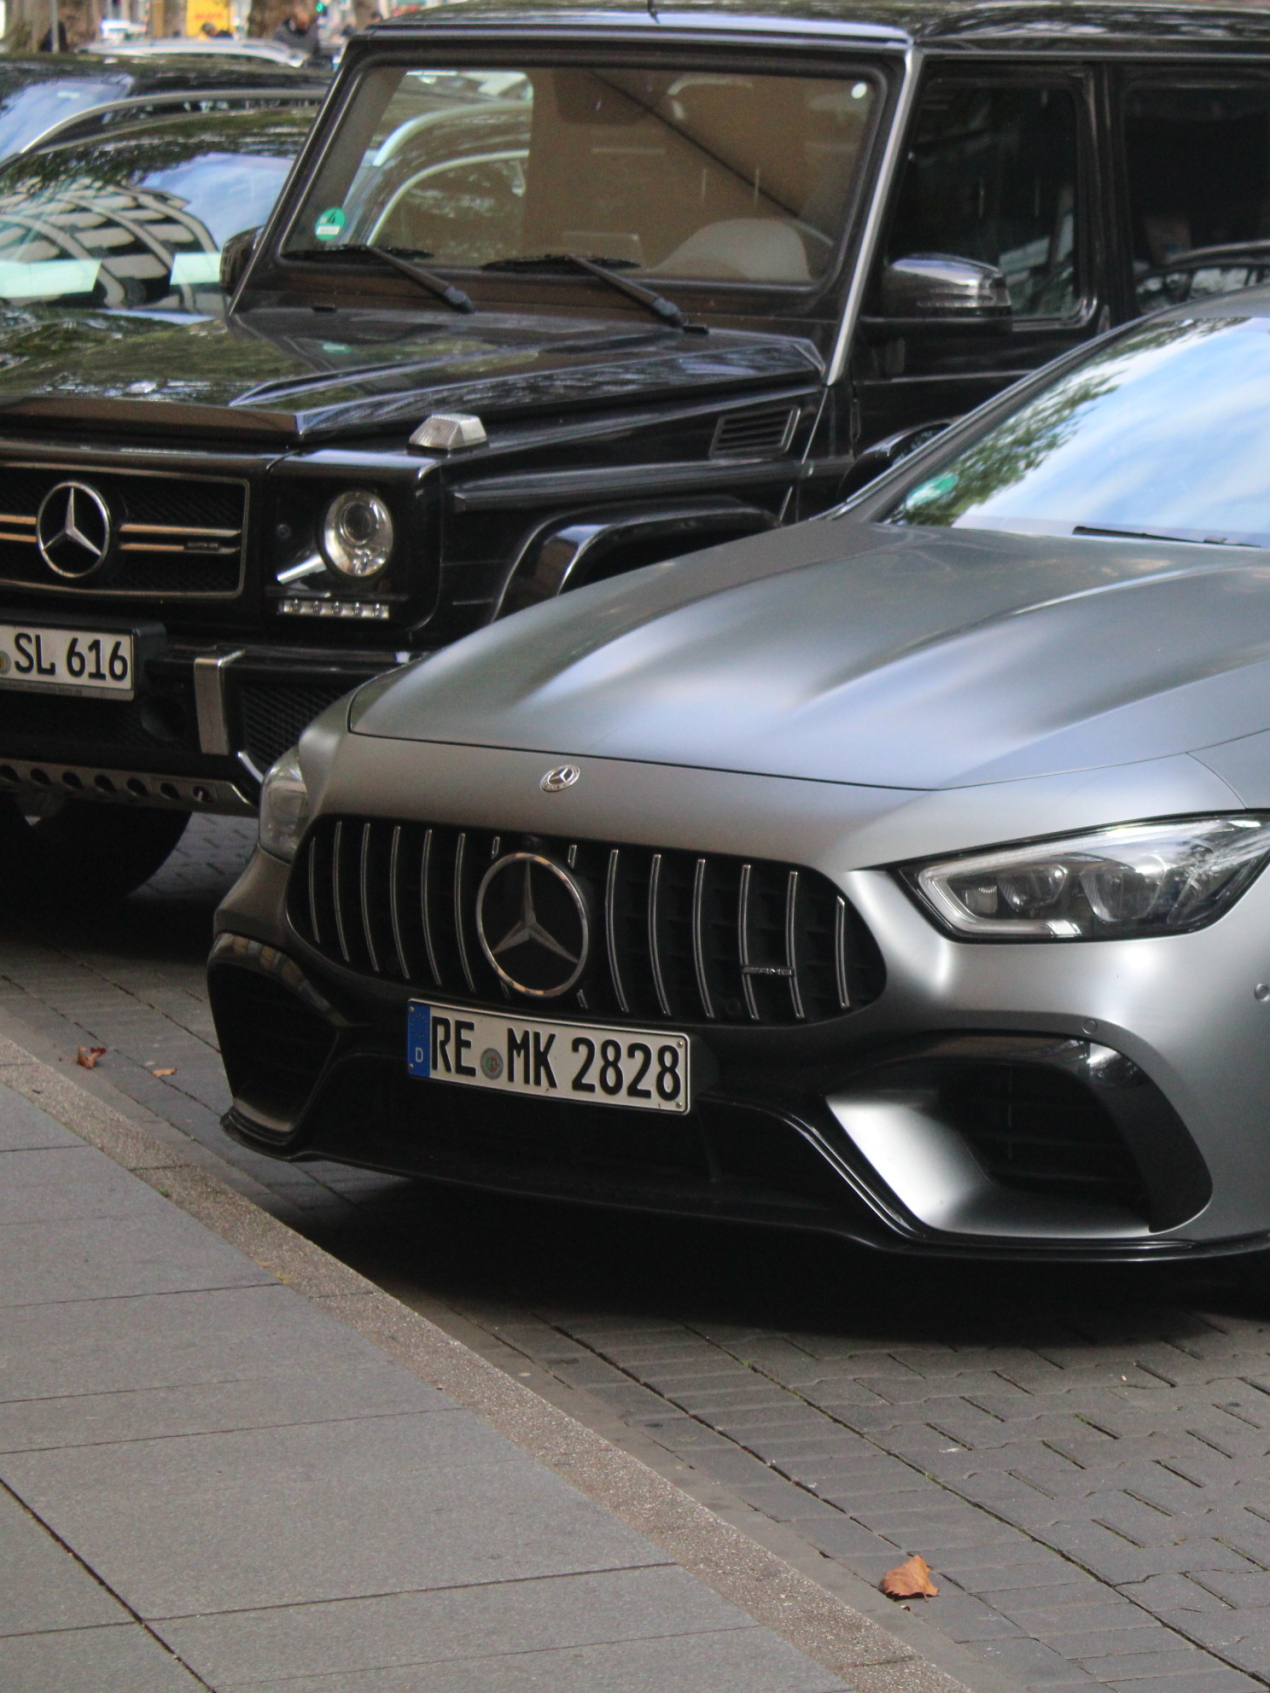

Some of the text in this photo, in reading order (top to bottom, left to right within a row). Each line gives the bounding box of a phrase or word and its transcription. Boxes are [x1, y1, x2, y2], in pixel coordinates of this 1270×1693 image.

[14, 632, 128, 682] SL 616
[415, 1046, 424, 1063] D
[431, 1016, 682, 1102] RE MK 2828
